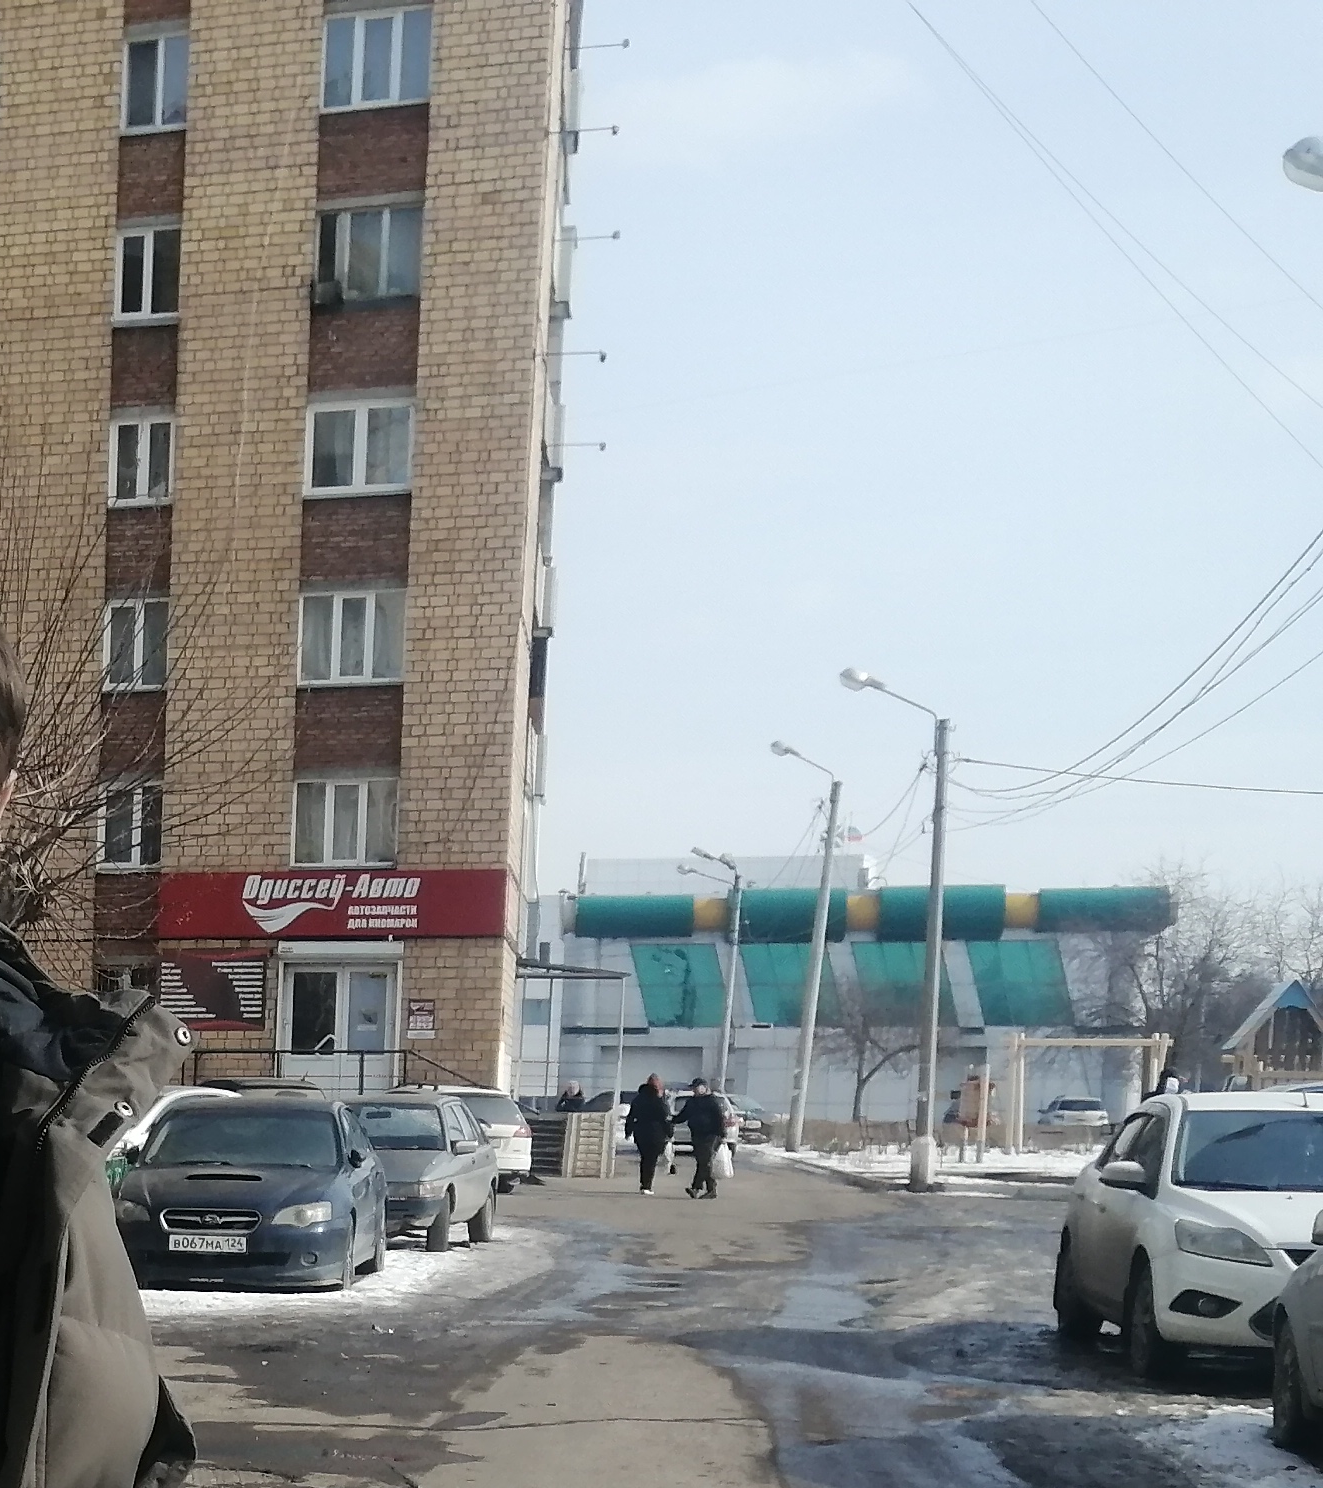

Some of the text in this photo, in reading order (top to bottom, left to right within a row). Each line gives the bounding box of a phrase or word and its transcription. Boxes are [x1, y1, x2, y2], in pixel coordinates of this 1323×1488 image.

[242, 873, 421, 906] Одиссей-Авто
[347, 904, 418, 916] АВТОЗАПЧАСТИ
[173, 1237, 244, 1250] В067МА 124
